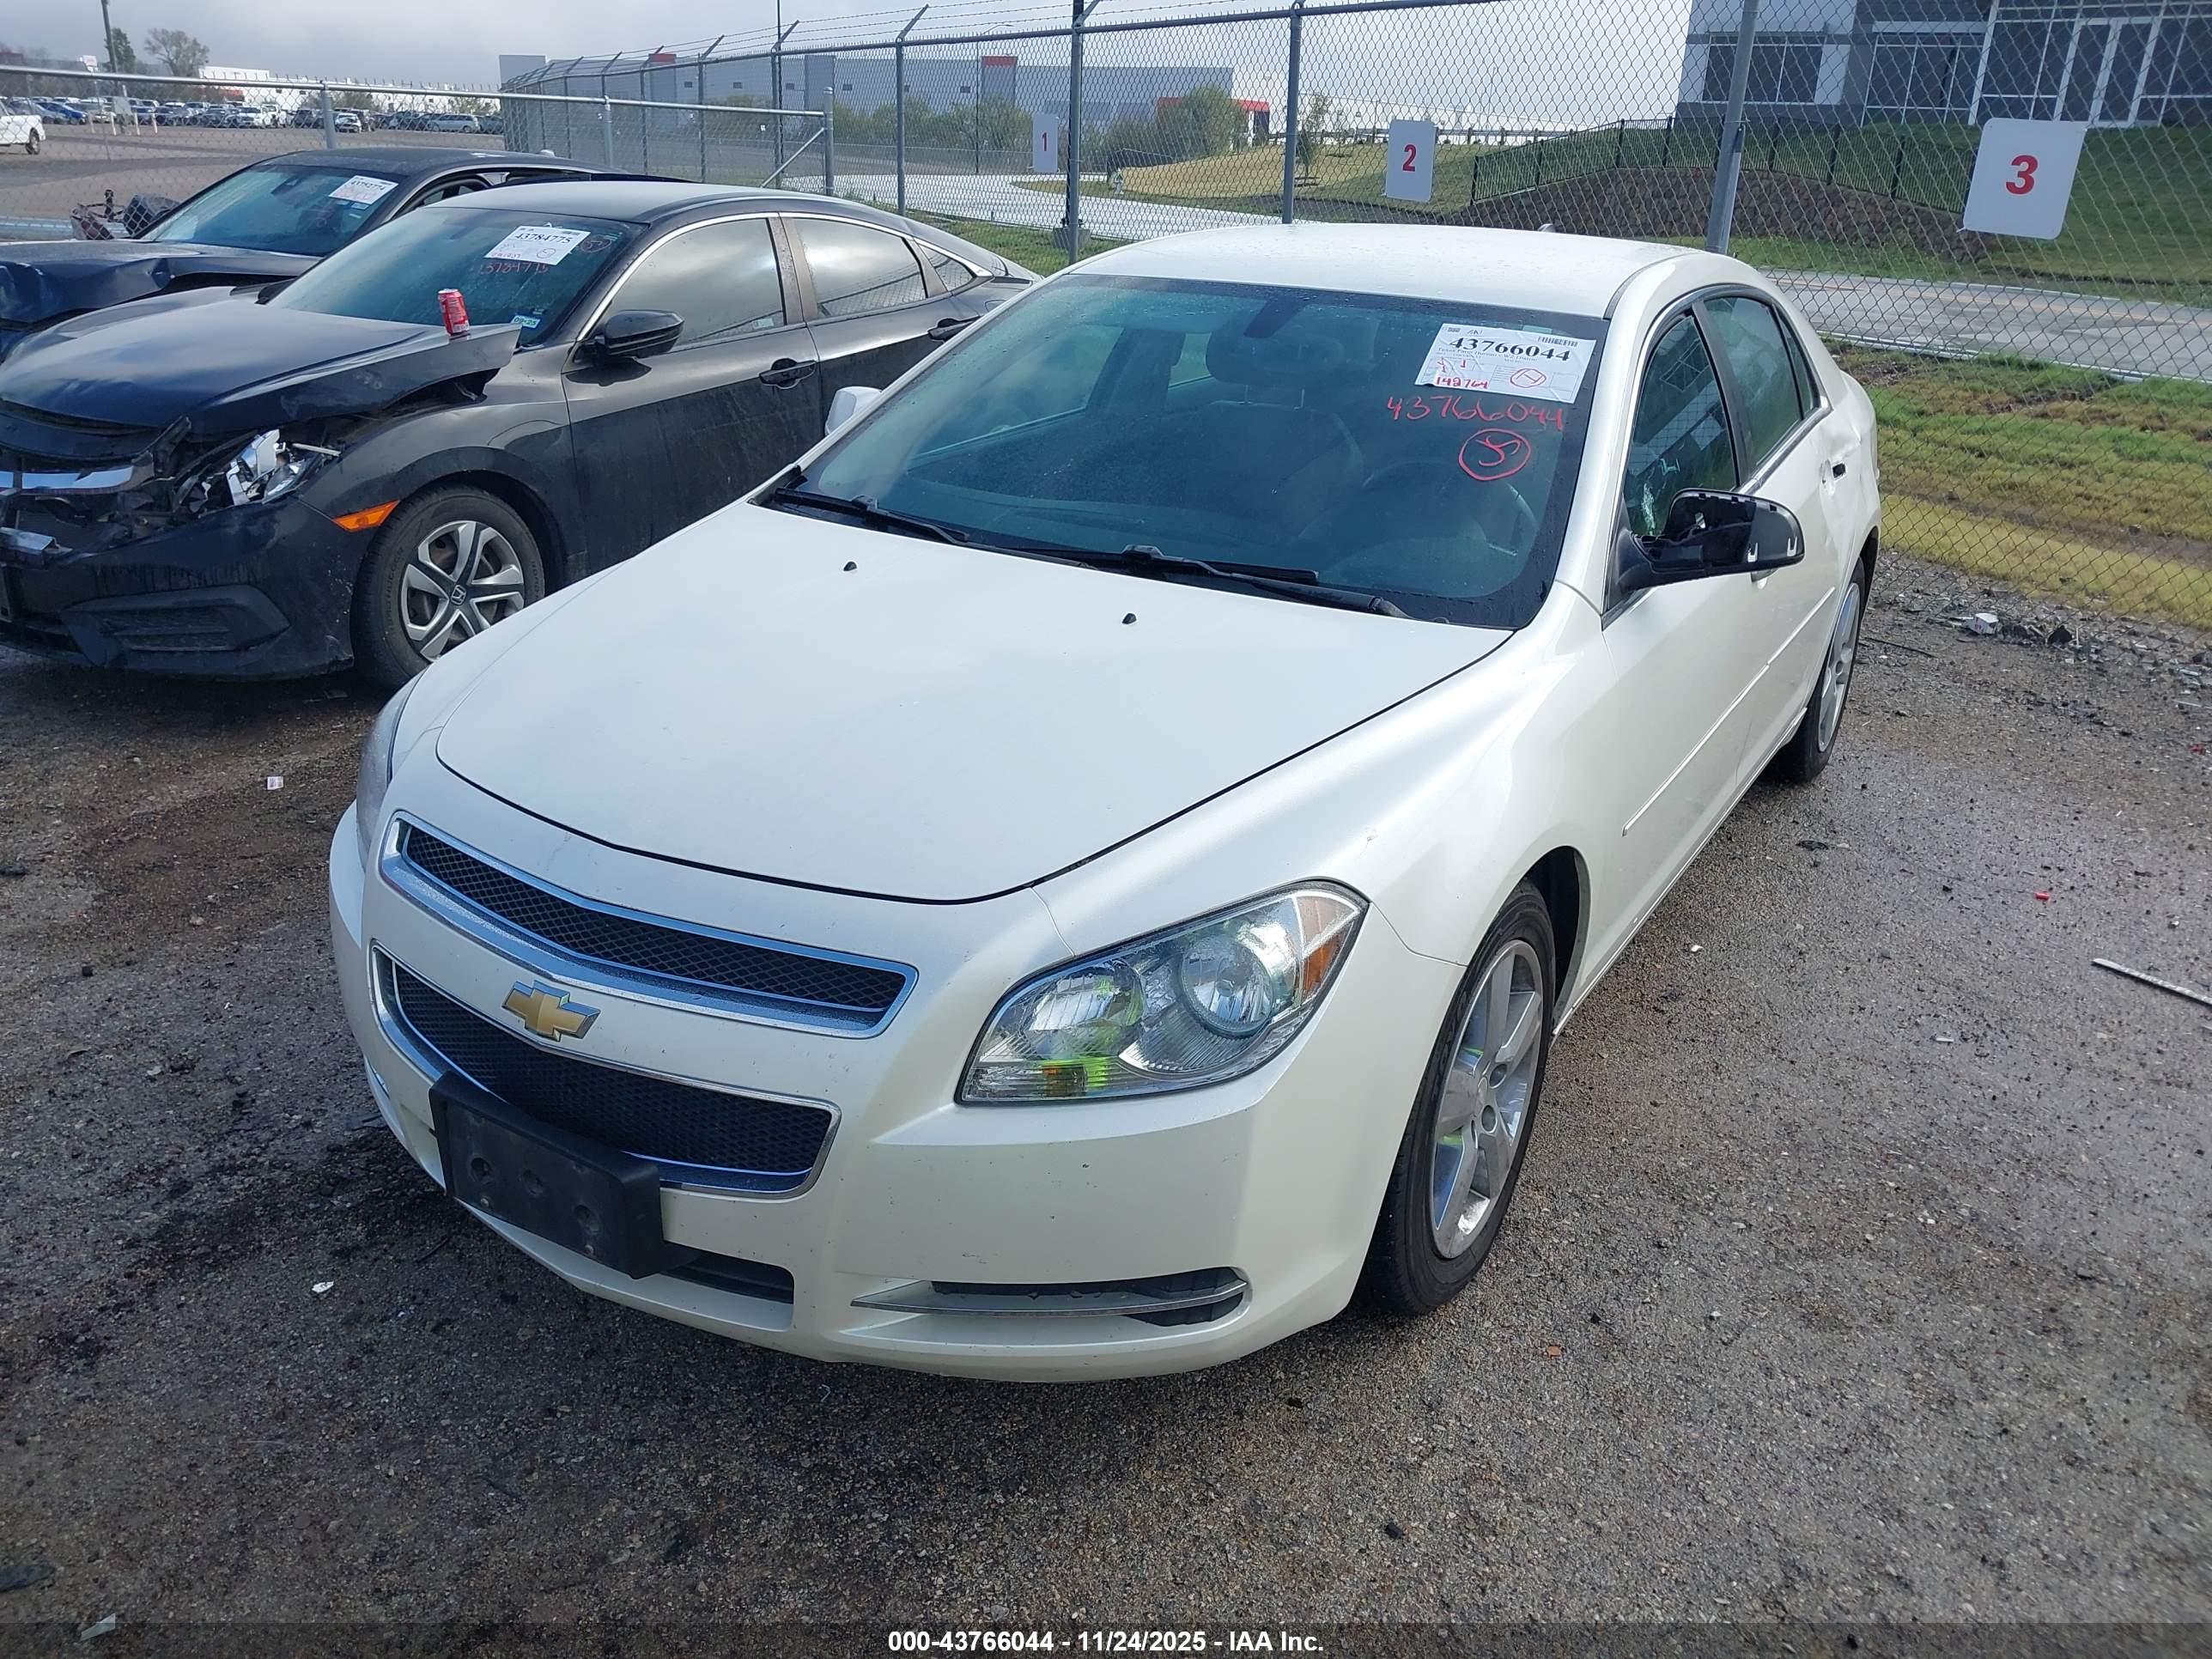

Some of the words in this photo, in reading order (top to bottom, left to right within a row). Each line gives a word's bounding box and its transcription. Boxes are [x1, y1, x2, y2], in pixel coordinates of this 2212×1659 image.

[1041, 131, 1048, 152] 1
[1402, 143, 1417, 172] 2
[2005, 155, 2039, 195] 3
[515, 232, 573, 244] 43784775
[1449, 337, 1571, 362] 43766044
[1387, 395, 1563, 430] 43766044
